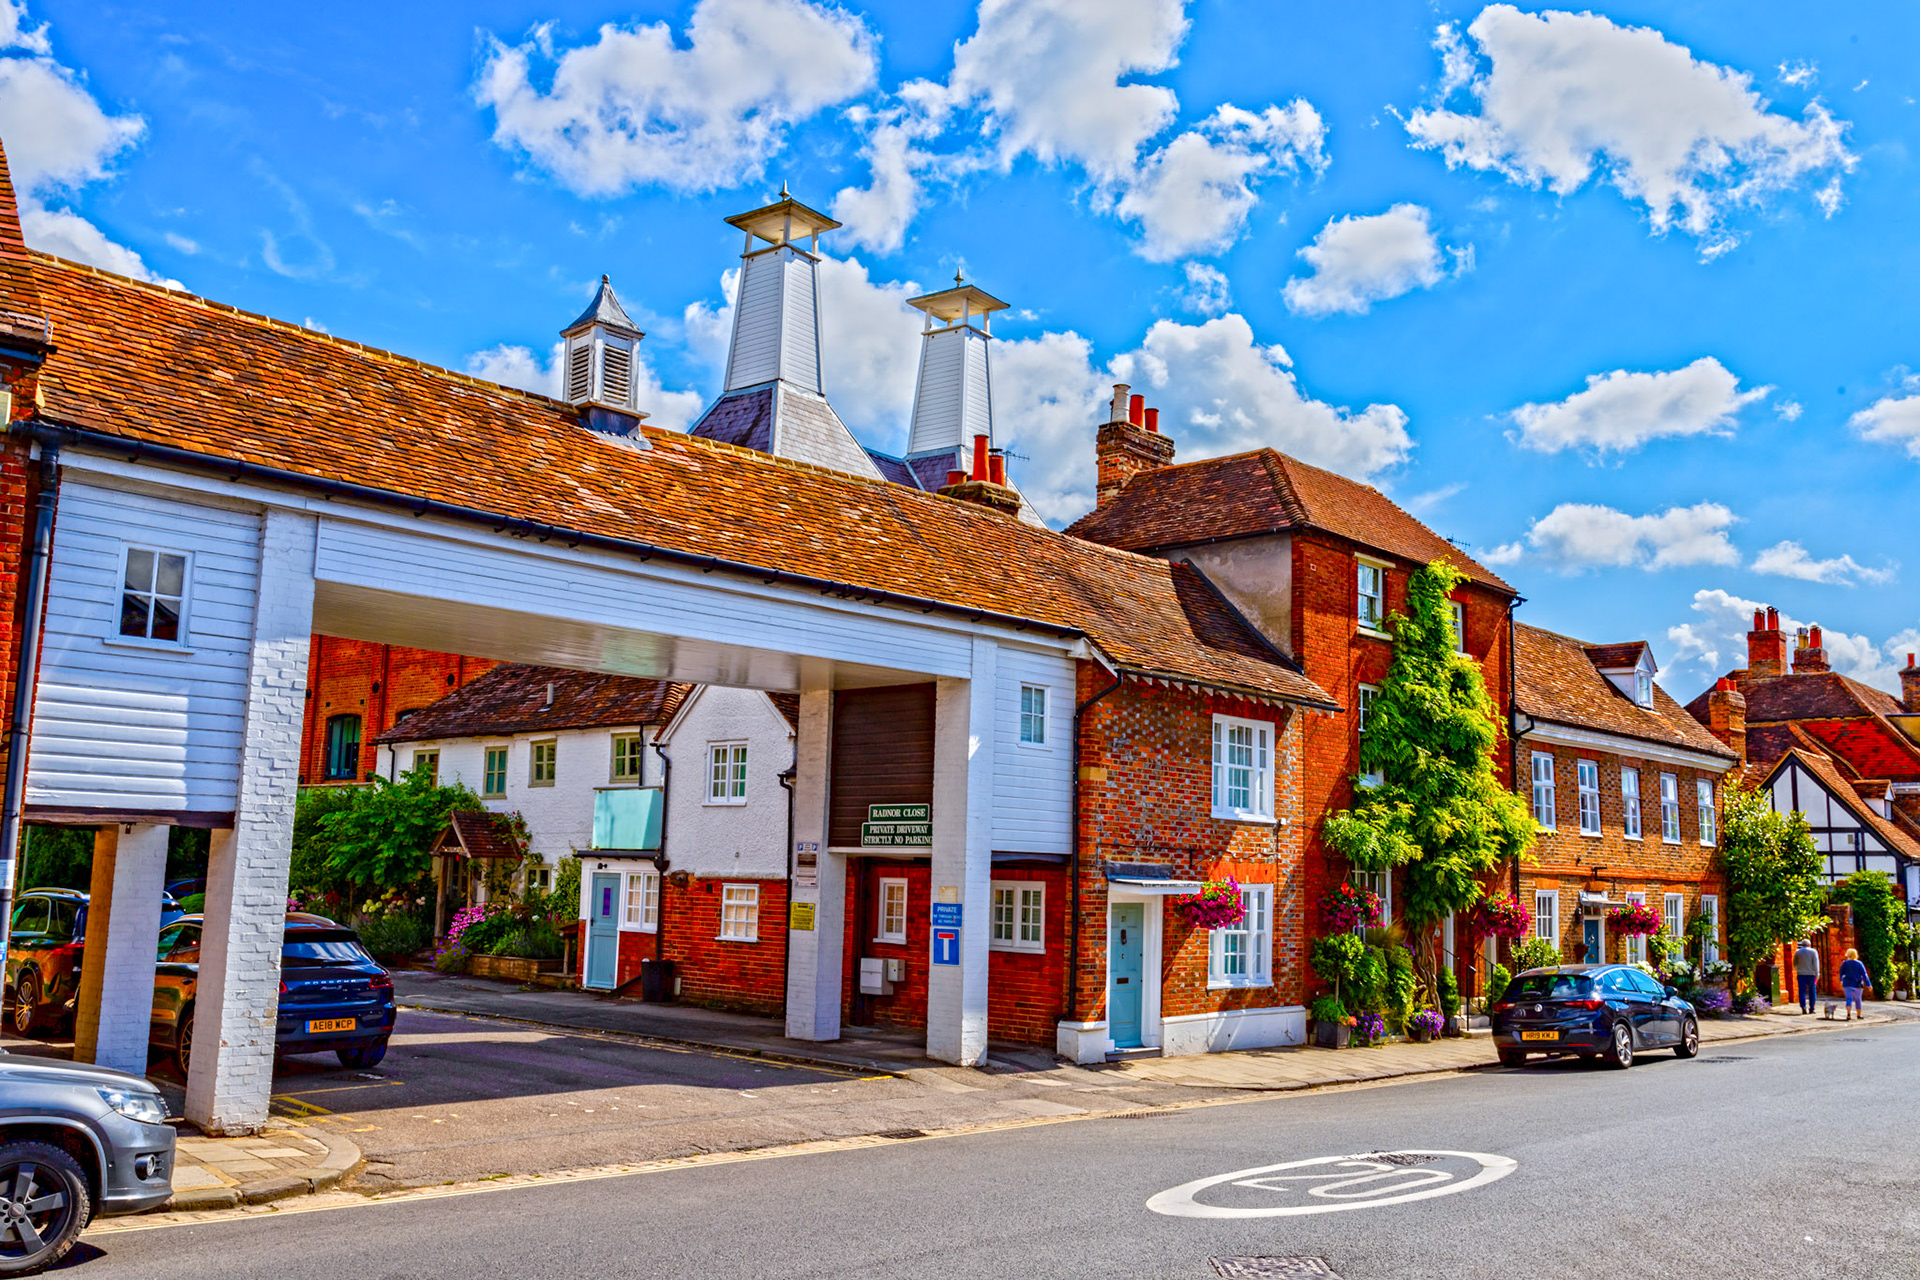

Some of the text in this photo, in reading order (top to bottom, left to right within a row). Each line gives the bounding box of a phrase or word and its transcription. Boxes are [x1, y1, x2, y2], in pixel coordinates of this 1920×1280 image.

[873, 808, 926, 817] RADNOR CLOSE
[869, 825, 928, 833] PRIVATE DRIVEWAY
[864, 835, 893, 844] STRICTLY
[894, 836, 903, 844] NO
[937, 905, 957, 913] PRIVATE
